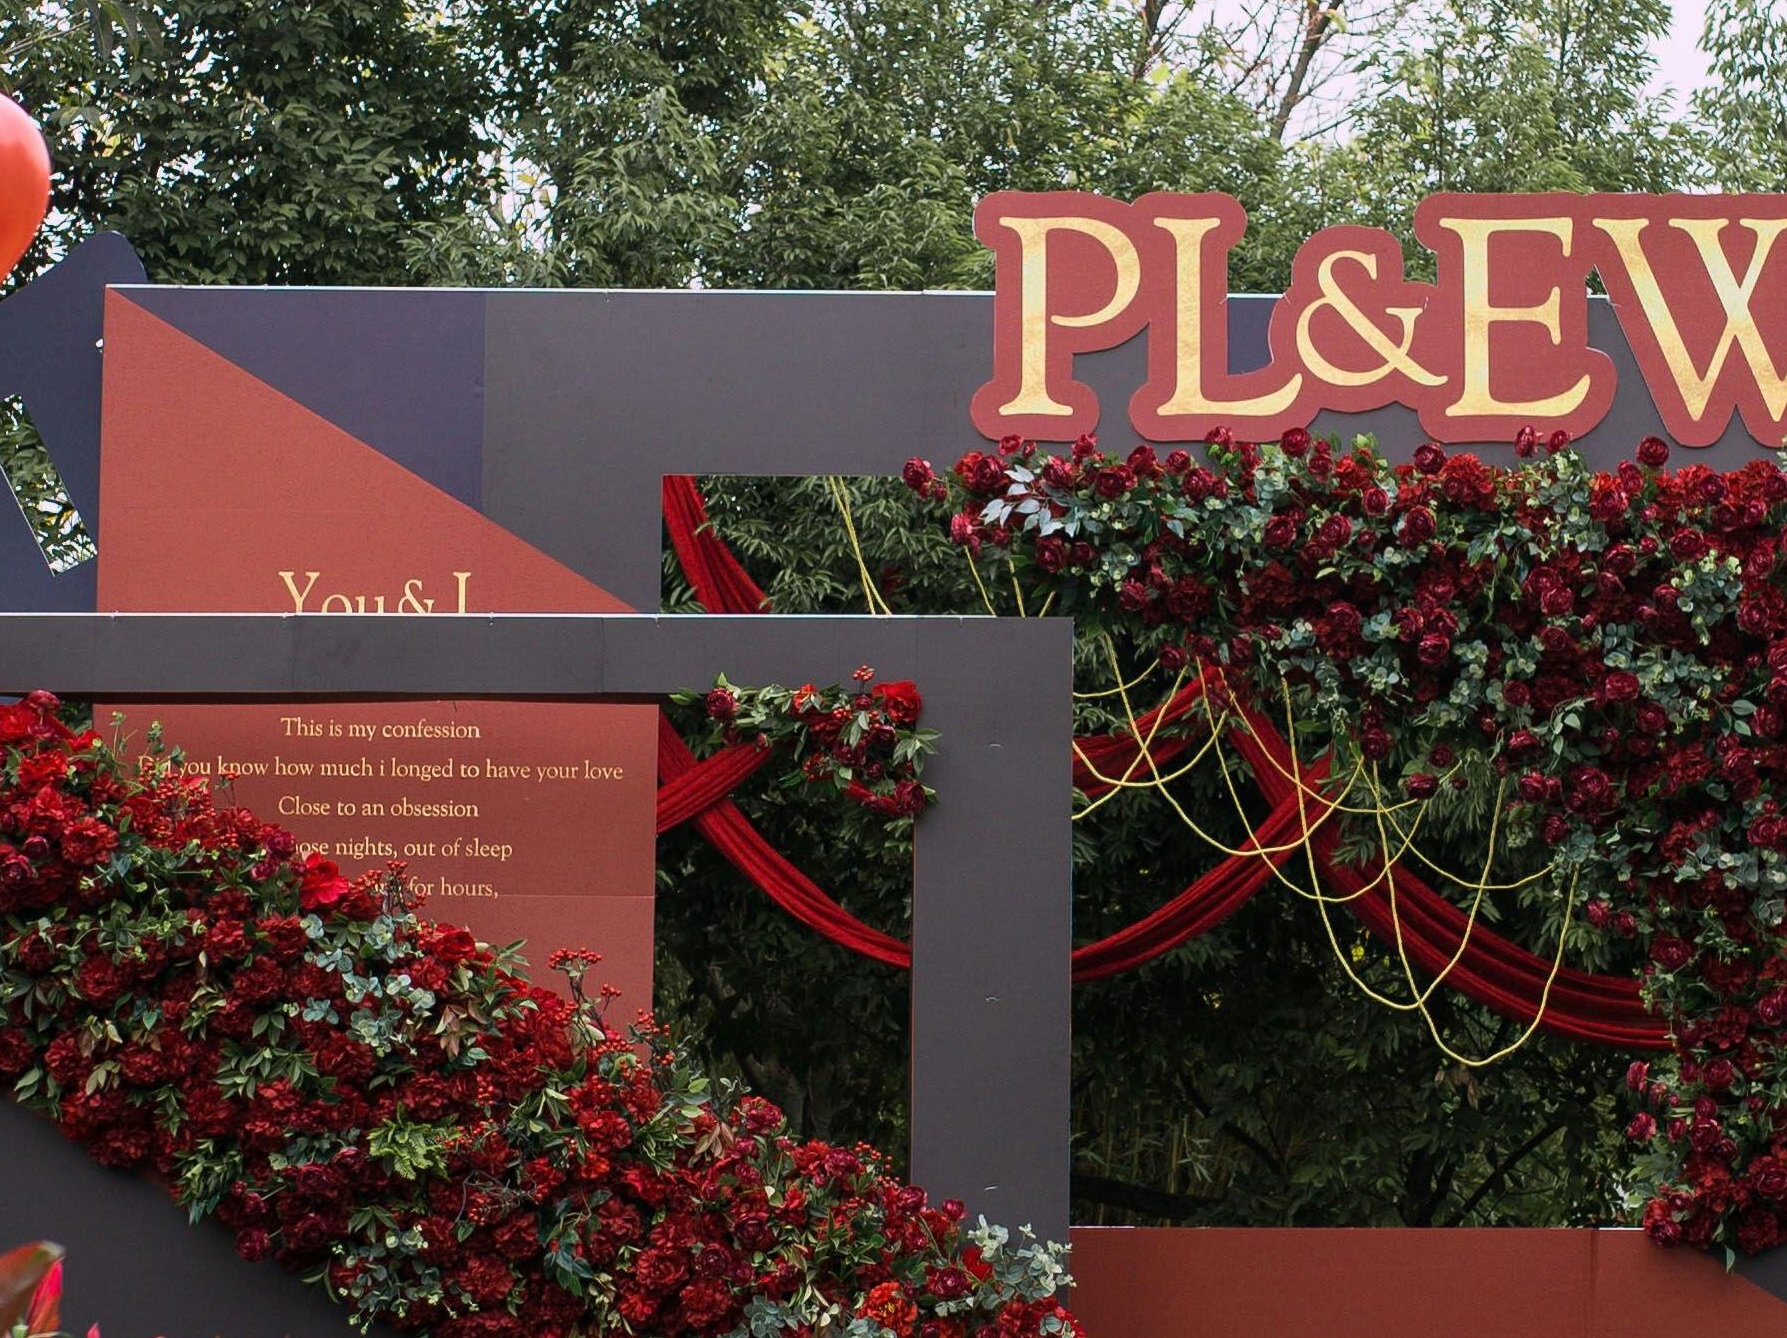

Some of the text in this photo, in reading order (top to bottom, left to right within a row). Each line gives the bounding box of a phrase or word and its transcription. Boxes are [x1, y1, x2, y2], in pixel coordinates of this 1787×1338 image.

[280, 716, 481, 742] This is my confession
[179, 760, 211, 779] you
[217, 755, 269, 776] know
[274, 755, 314, 776] how
[320, 756, 373, 777] much
[380, 759, 385, 777] i
[391, 757, 453, 782] longed
[460, 764, 480, 778] to
[486, 758, 531, 779] have
[537, 766, 579, 783] your
[584, 759, 623, 780] love
[278, 795, 479, 817] Close to an obsession
[335, 836, 398, 860] nights,
[403, 842, 436, 857] out
[441, 837, 463, 857] of
[465, 837, 513, 862] sleep
[409, 876, 435, 896] for
[440, 876, 498, 899] hours,
